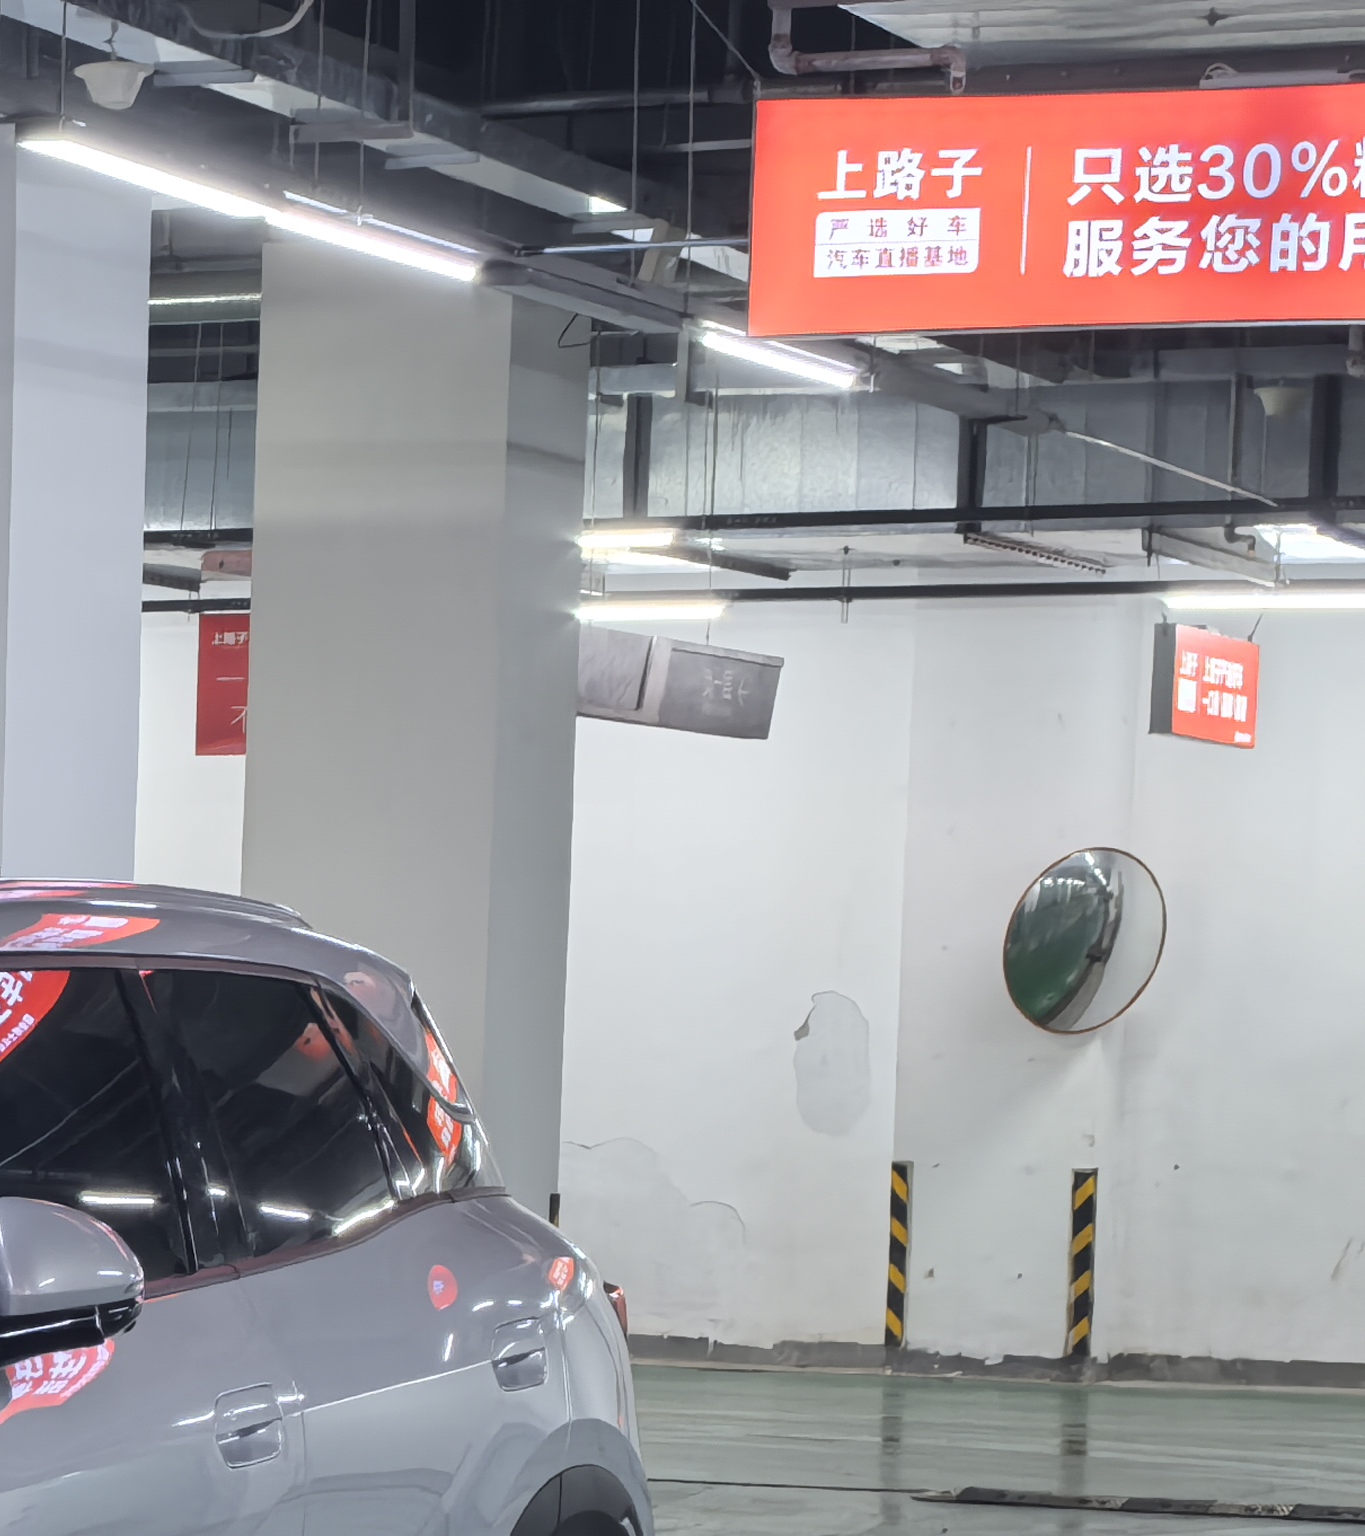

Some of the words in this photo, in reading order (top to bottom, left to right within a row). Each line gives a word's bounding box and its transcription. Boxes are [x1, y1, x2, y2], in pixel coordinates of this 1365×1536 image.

[816, 147, 984, 201] 上路子
[829, 215, 968, 241] 严选好车
[827, 245, 969, 270] 汽车直播基地
